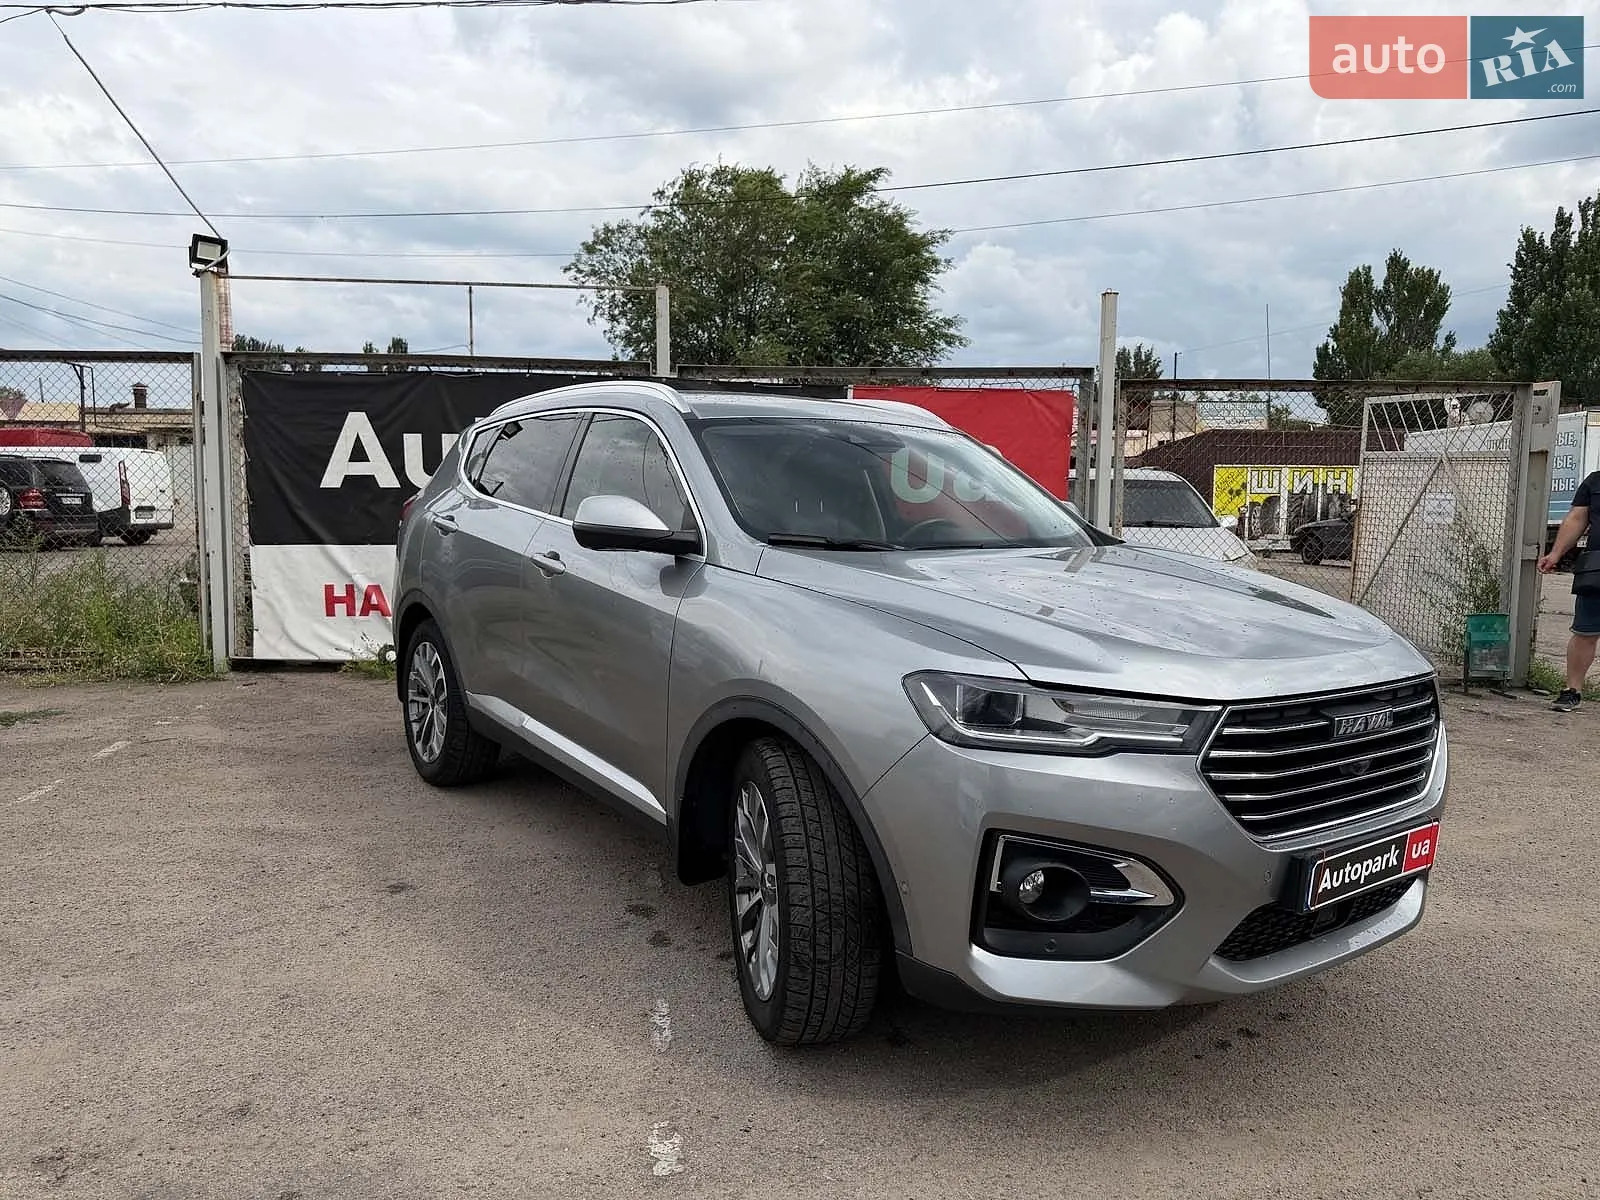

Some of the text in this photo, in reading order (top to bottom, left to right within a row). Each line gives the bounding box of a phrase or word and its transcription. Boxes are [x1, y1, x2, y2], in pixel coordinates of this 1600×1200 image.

[1556, 431, 1577, 447] ЫЕ,
[1338, 711, 1394, 736] HAVAL
[1317, 839, 1431, 894] Autopark ua
